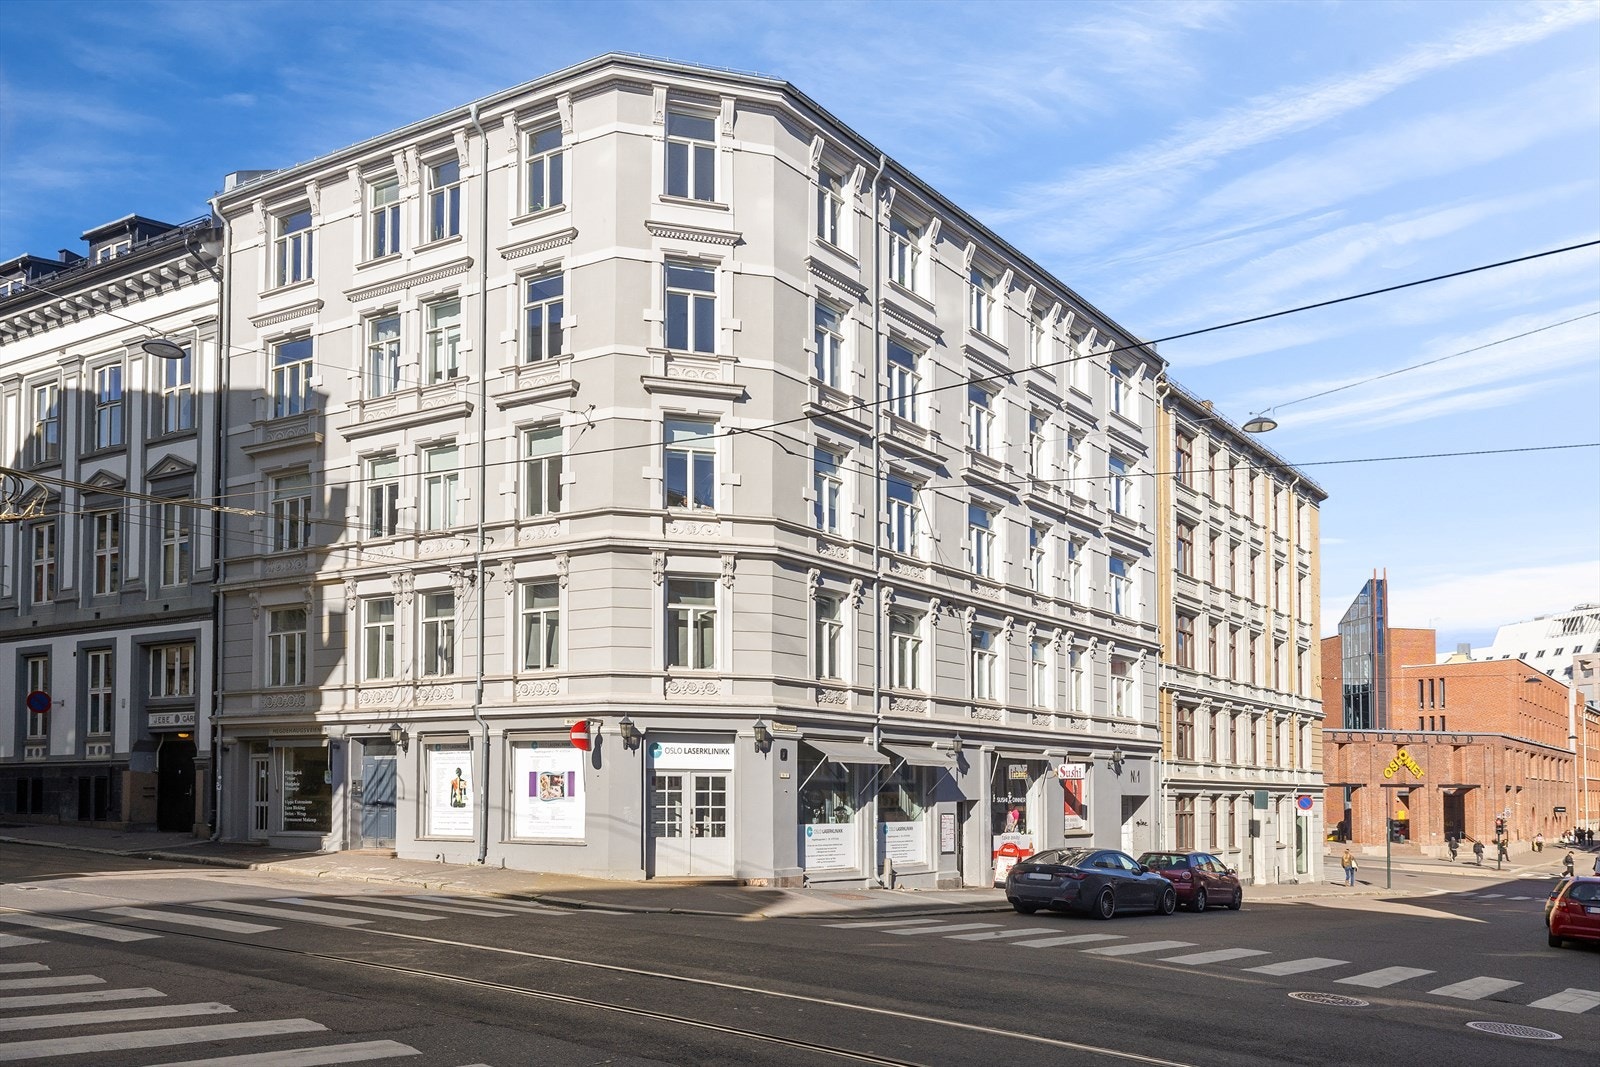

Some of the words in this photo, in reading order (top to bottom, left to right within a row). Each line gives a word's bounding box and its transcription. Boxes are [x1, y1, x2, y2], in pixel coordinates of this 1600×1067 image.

[153, 716, 170, 724] JEBE
[1331, 732, 1474, 744] FRYDENLUND
[683, 747, 730, 755] LASERKLINIKK
[1059, 765, 1082, 778] Sushi
